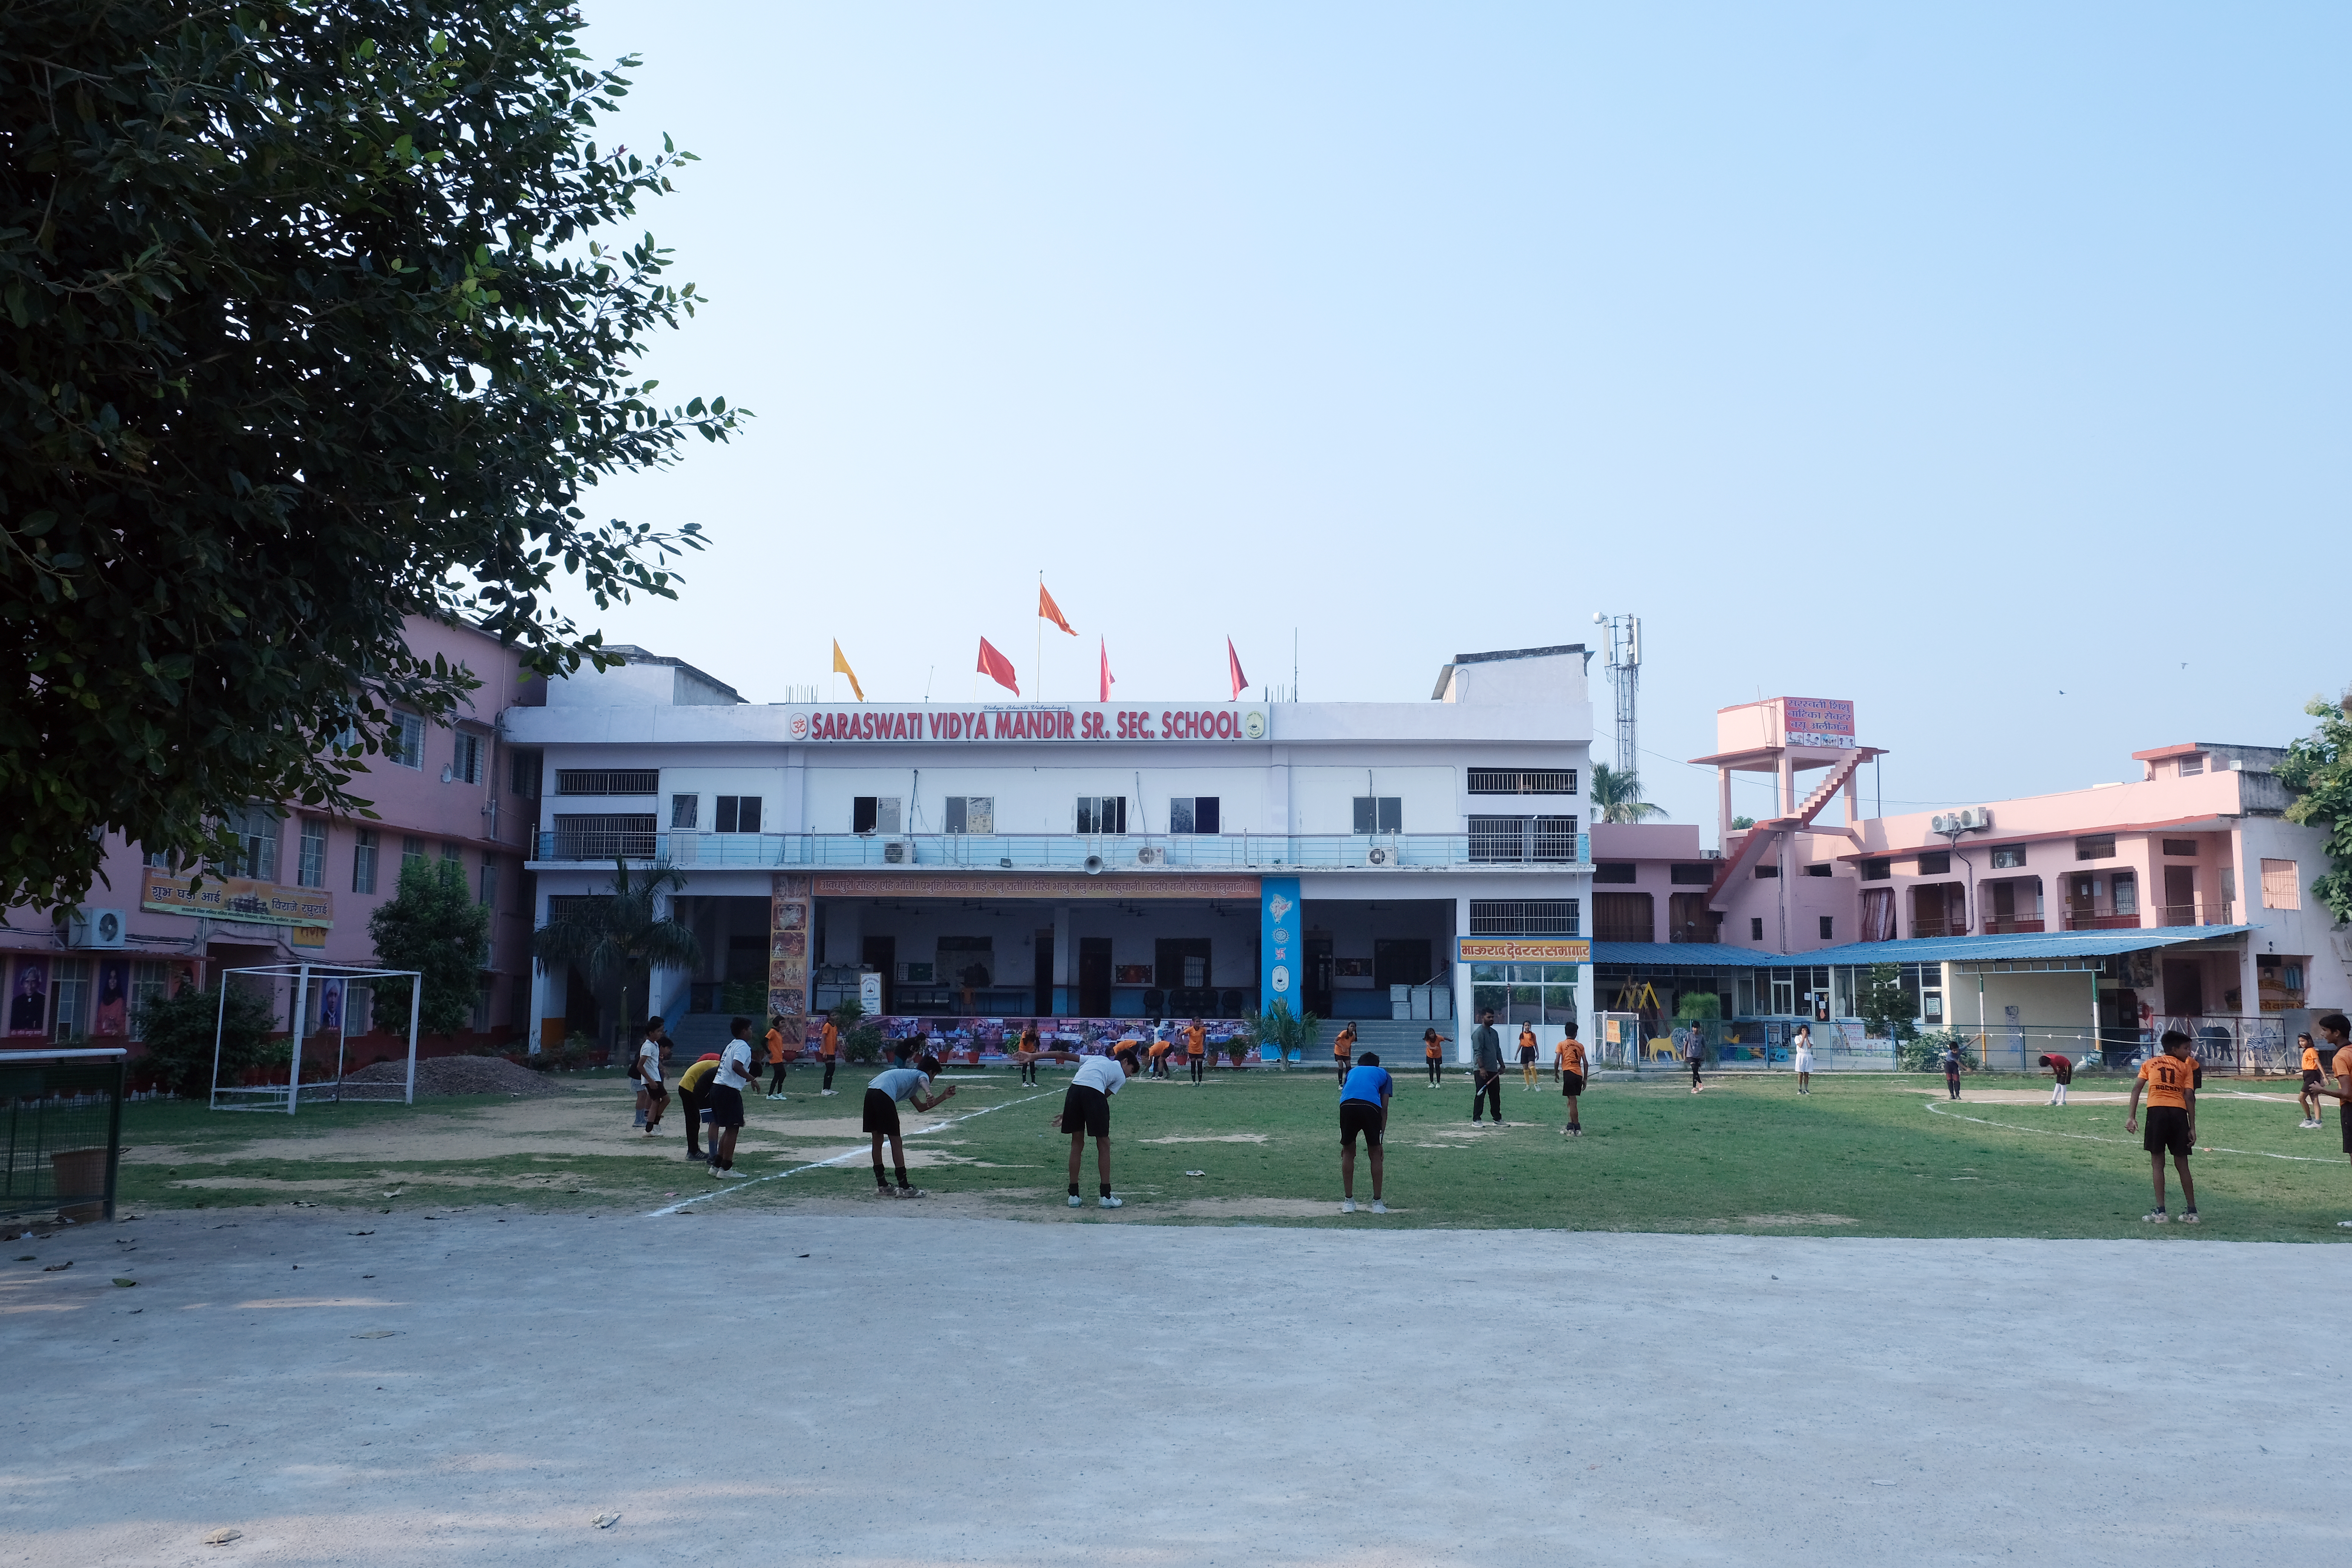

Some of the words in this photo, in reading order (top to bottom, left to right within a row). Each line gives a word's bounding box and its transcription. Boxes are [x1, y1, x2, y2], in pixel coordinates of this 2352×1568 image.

[1787, 700, 1826, 708] सरस्वती
[1829, 700, 1850, 713] शिशु
[1787, 709, 1821, 718] वाटिका
[1824, 711, 1851, 721] सेक्टर
[812, 712, 922, 739] SARASWATI
[928, 712, 988, 739] VIDYA
[994, 712, 1075, 739] MANDIR
[1081, 711, 1110, 739] SR.
[1116, 711, 1155, 738] SEC.
[1161, 711, 1242, 738] SCHOOL
[1790, 721, 1808, 731] क्यू
[1809, 721, 1848, 731] अलीगंज
[820, 878, 854, 893] अवधपुरी
[856, 879, 877, 891] सोहइ
[879, 878, 894, 890] एहि
[920, 879, 943, 893] प्रभुहि
[943, 879, 968, 891] मिलन
[971, 879, 988, 892] आई
[989, 881, 1005, 894] जनु
[1031, 879, 1050, 891] देखि
[1053, 881, 1070, 894] भानु
[1071, 881, 1087, 894] जनु
[1089, 882, 1103, 891] मन
[1146, 880, 1167, 892] तदपि
[1169, 880, 1186, 892] बनी
[1188, 879, 1209, 892] संध्या
[151, 886, 173, 901] शुभ
[201, 890, 221, 903] आई
[272, 897, 298, 911] विराजे
[301, 903, 328, 917] रघुराई
[1461, 945, 1505, 957] भाऊराव
[1506, 942, 1546, 960] देवरस
[1545, 946, 1589, 957] सभागार
[2157, 1067, 2175, 1084] 17
